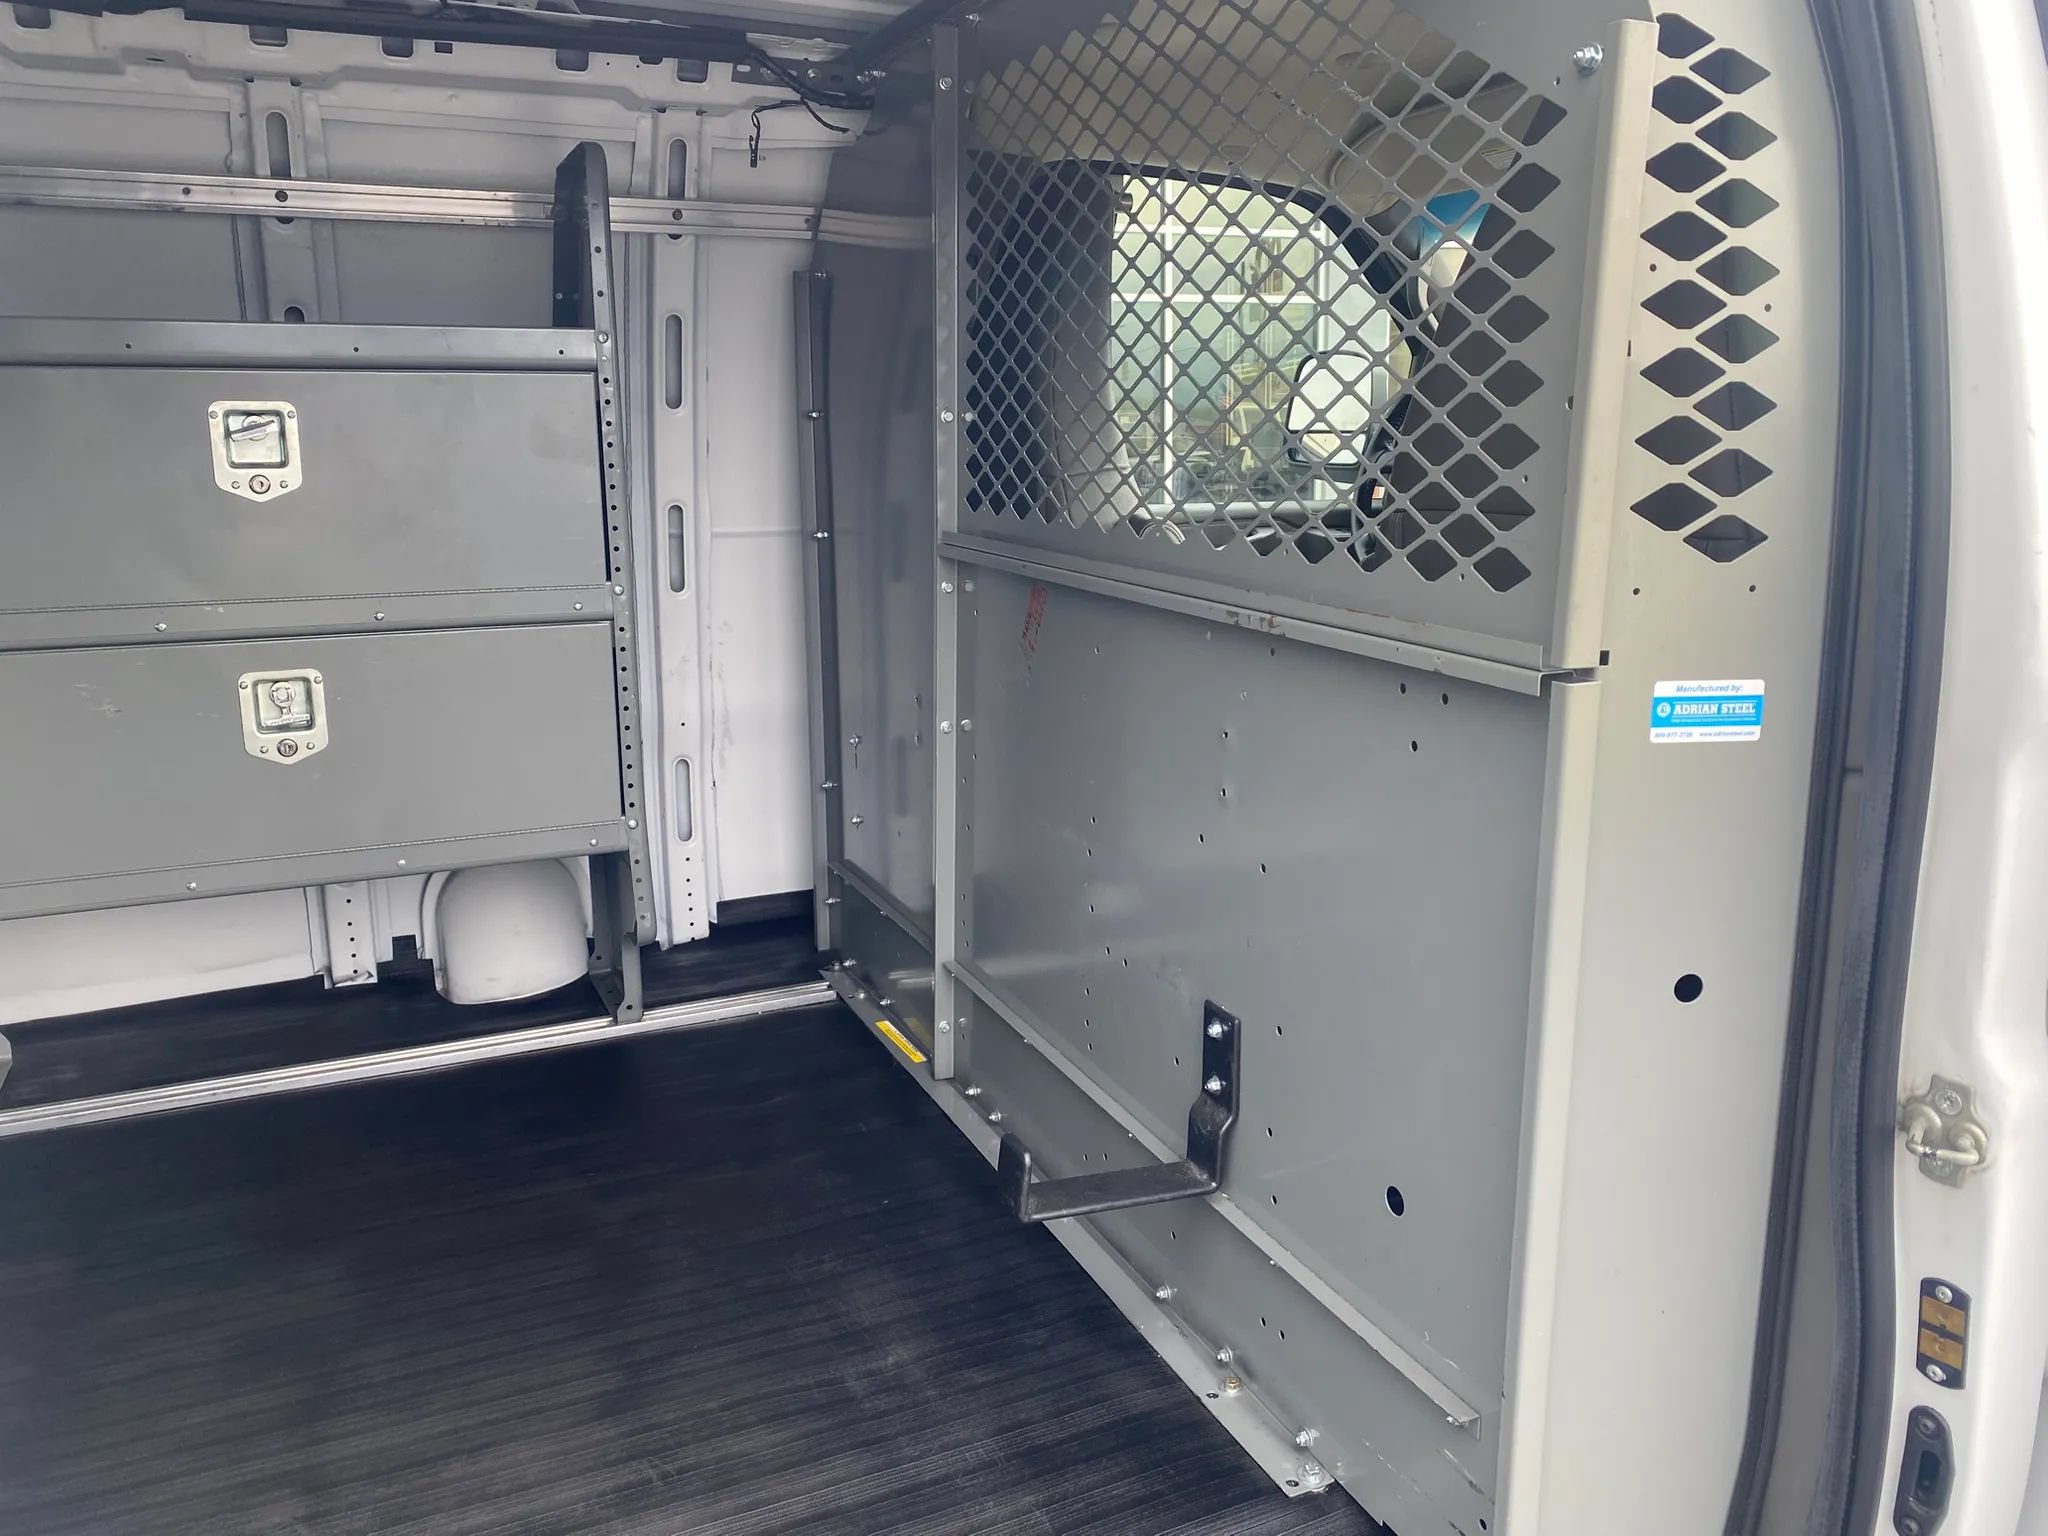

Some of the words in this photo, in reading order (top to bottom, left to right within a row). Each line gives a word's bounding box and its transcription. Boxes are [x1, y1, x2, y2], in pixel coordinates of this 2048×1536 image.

[1675, 684, 1729, 693] Manufactured
[1730, 684, 1744, 693] by:
[1673, 703, 1719, 714] ADRIAN
[1721, 703, 1756, 714] STEEL
